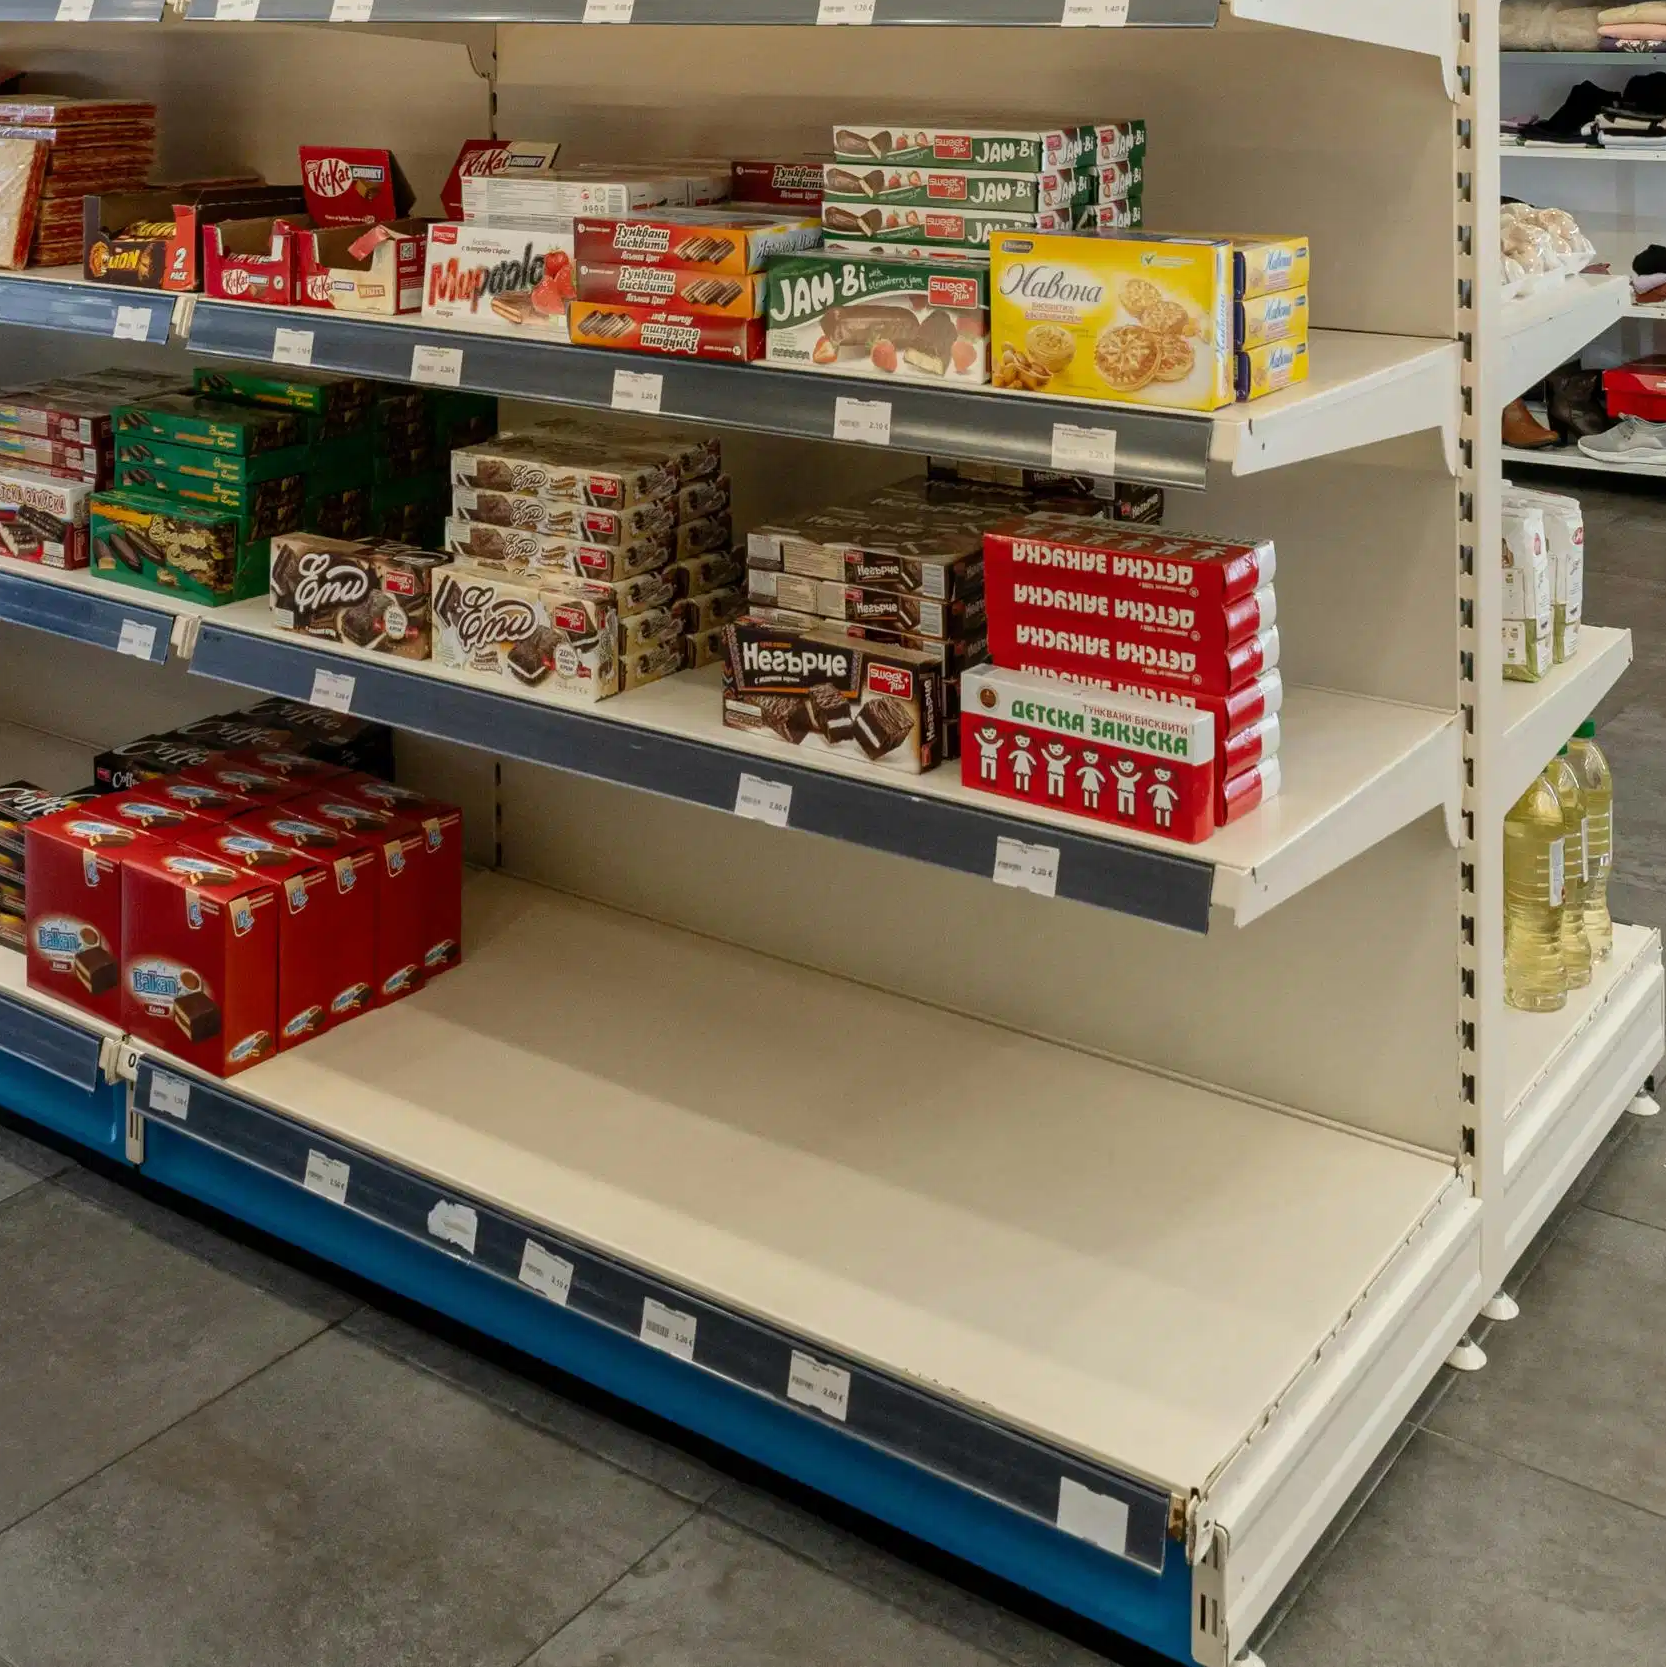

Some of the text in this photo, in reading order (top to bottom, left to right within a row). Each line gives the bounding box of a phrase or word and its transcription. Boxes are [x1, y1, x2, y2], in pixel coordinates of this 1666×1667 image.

[463, 151, 509, 176] KitKat
[976, 139, 1035, 164] JAM-Bi
[312, 159, 383, 196] KitKat CHUNKY
[970, 178, 1031, 203] JAM-Bi
[614, 237, 669, 251] бисквити
[617, 224, 669, 240] Тунквани
[108, 251, 138, 271] LION
[174, 247, 187, 269] 2
[170, 272, 187, 281] PACK
[223, 270, 249, 293] KitKat
[618, 280, 674, 294] бисквити
[620, 266, 675, 283] Тунквани
[868, 275, 925, 291] strawberry jam
[1000, 262, 1104, 304] Навона
[770, 265, 866, 323] JAM-Bi
[857, 564, 900, 578] Негърче
[1012, 542, 1194, 585] ДЕТСКА ЗАКУСКА
[856, 601, 898, 615] Негърче
[1013, 584, 1195, 629] ДЕТСКА ЗАКУСКА
[741, 642, 848, 678] Негърче
[1016, 624, 1197, 673] ДЕТСКА ЗАКУСКА
[1011, 700, 1188, 757] ДЕТСКА ЗАКУСКА
[1083, 704, 1188, 735] ТУНКВАНИ БИСКВИТИ
[112, 772, 136, 788] Coff
[37, 927, 79, 952] Balkan
[133, 967, 177, 995] Balkan
